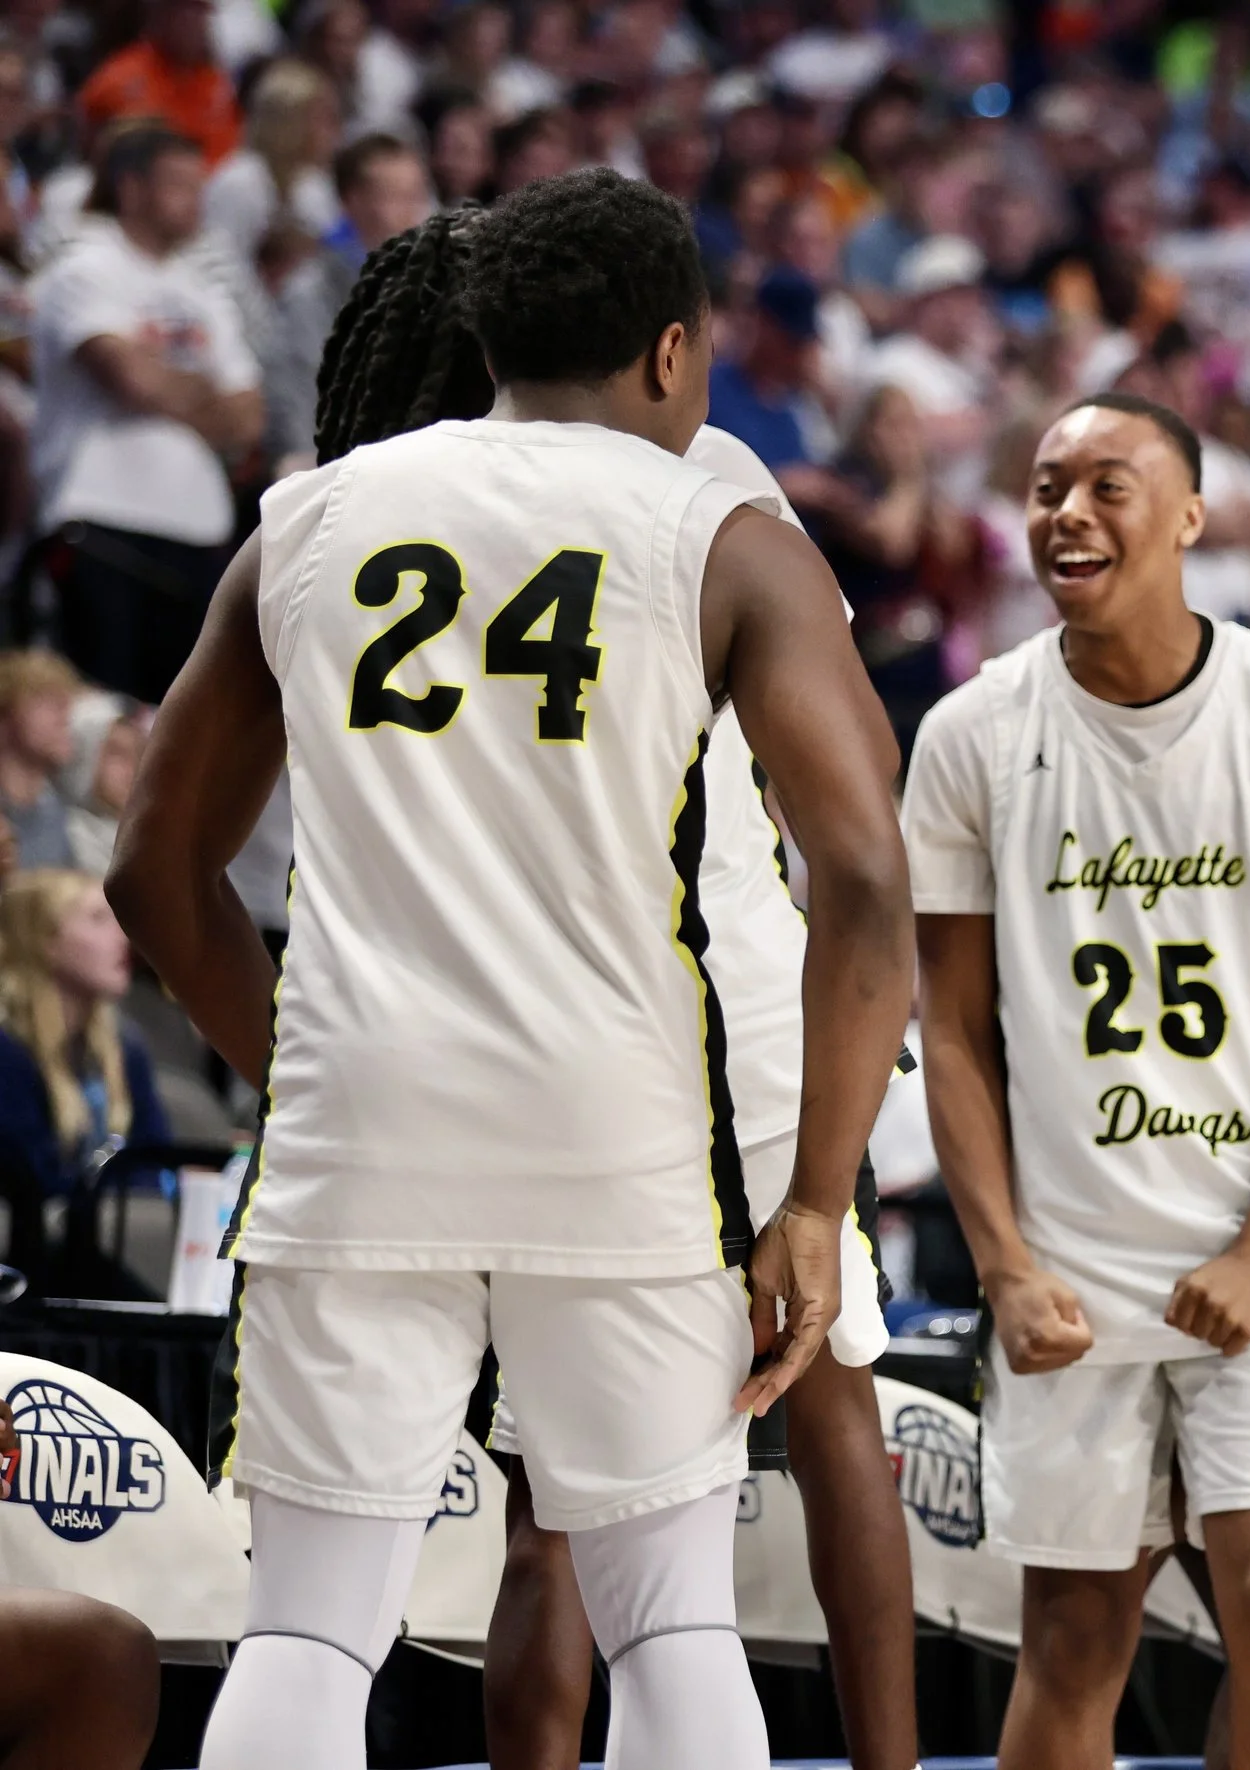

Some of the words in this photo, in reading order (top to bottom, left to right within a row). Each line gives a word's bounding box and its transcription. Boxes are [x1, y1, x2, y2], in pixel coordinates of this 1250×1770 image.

[345, 537, 609, 747] 24
[1045, 830, 1246, 912] Lafayette
[1070, 938, 1229, 1063] 25
[51, 1508, 104, 1531] AHSAA
[890, 1445, 980, 1522] INA
